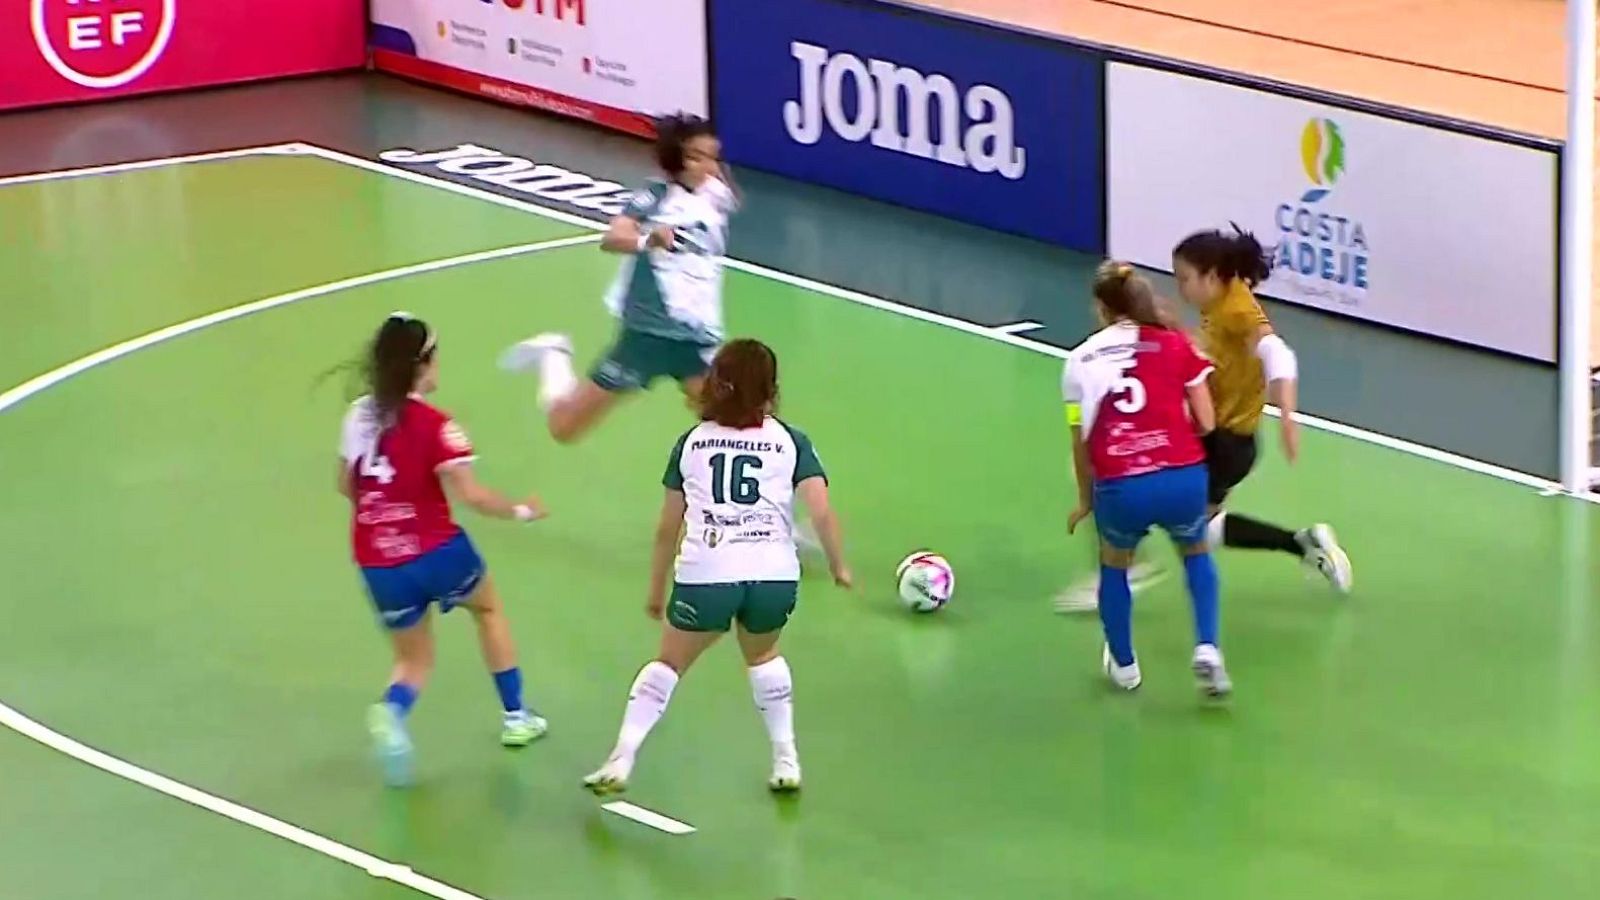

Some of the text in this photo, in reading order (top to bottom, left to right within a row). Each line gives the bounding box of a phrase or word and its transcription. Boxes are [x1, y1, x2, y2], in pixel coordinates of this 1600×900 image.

[66, 11, 145, 50] EF
[782, 40, 1027, 180] Joma
[1275, 203, 1370, 252] COSTA
[1276, 238, 1369, 290] ADEJE
[1108, 355, 1148, 414] 5
[359, 444, 397, 484] 4
[691, 437, 772, 452] MARIANGELES
[708, 452, 763, 505] 16
